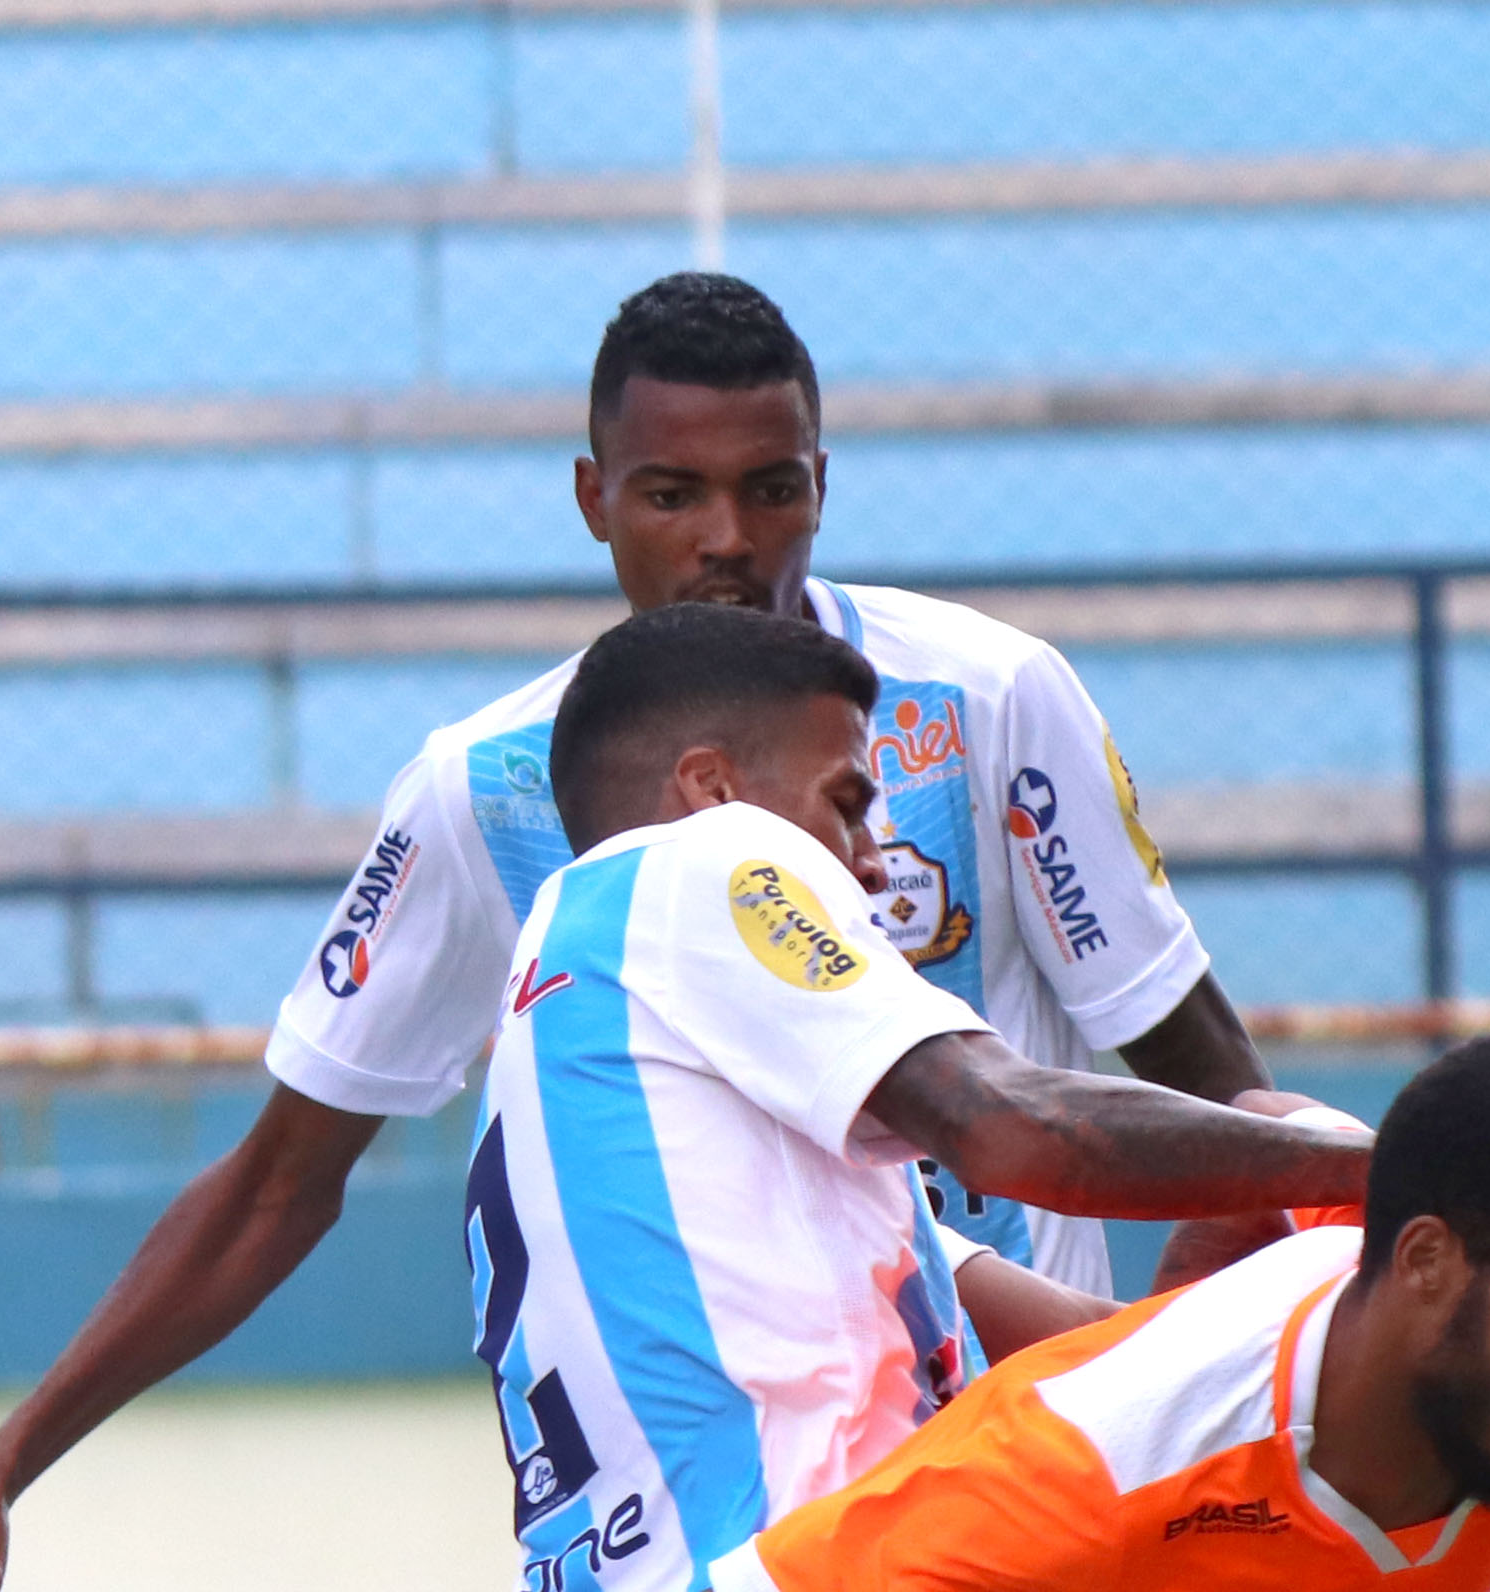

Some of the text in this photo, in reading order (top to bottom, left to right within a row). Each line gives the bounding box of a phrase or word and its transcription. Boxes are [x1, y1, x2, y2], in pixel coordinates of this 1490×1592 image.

[347, 822, 412, 934] SAME
[1032, 834, 1109, 960] SAME
[1163, 1497, 1290, 1542] BRASIL
